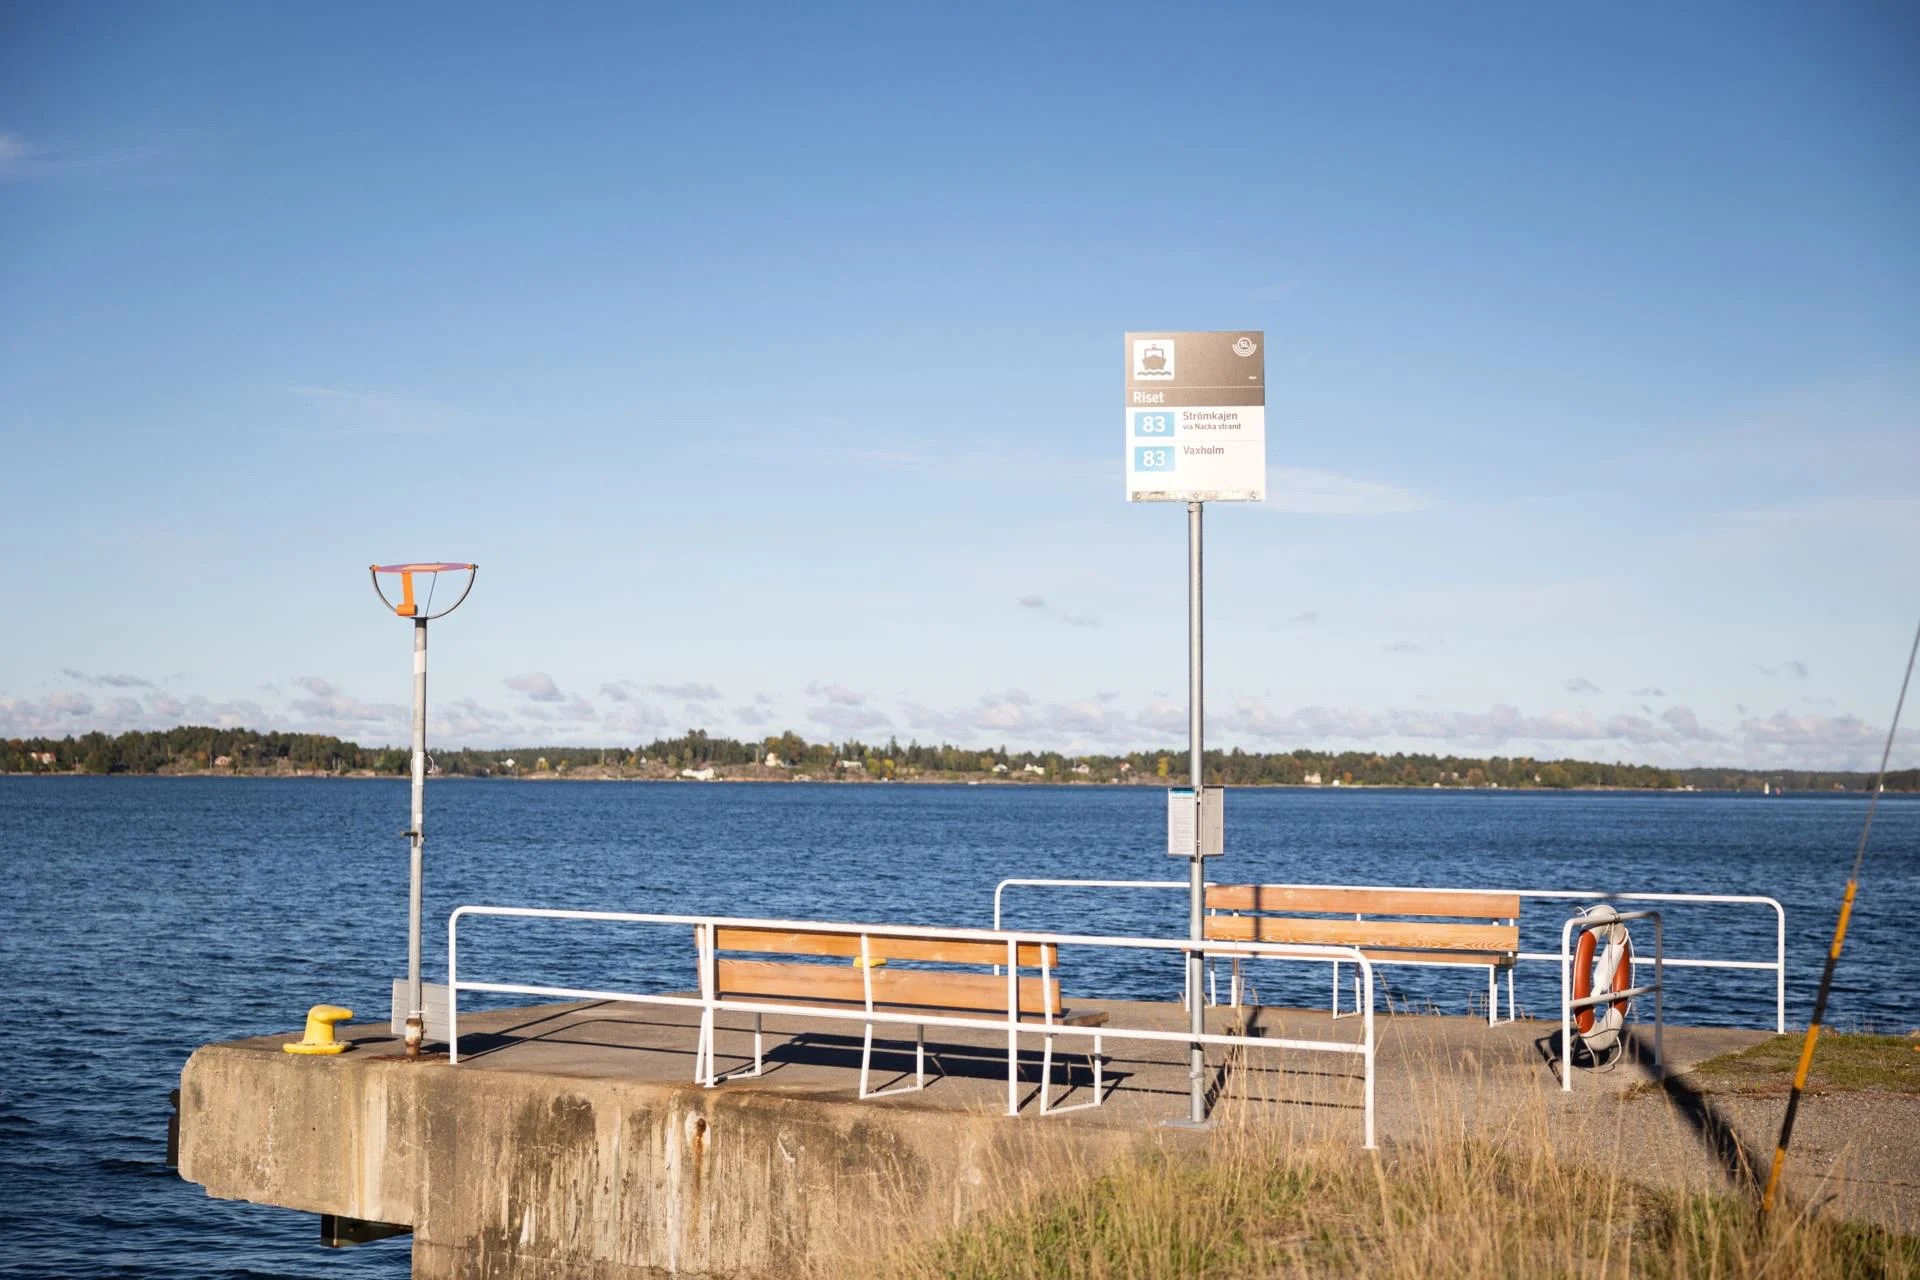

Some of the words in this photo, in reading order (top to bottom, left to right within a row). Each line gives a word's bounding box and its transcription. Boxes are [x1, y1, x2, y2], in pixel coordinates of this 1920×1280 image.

[1133, 391, 1165, 404] Riset
[1142, 416, 1166, 433] 83
[1183, 411, 1238, 423] Strömkajen
[1143, 450, 1166, 467] 83
[1183, 446, 1225, 455] Vaxholm
